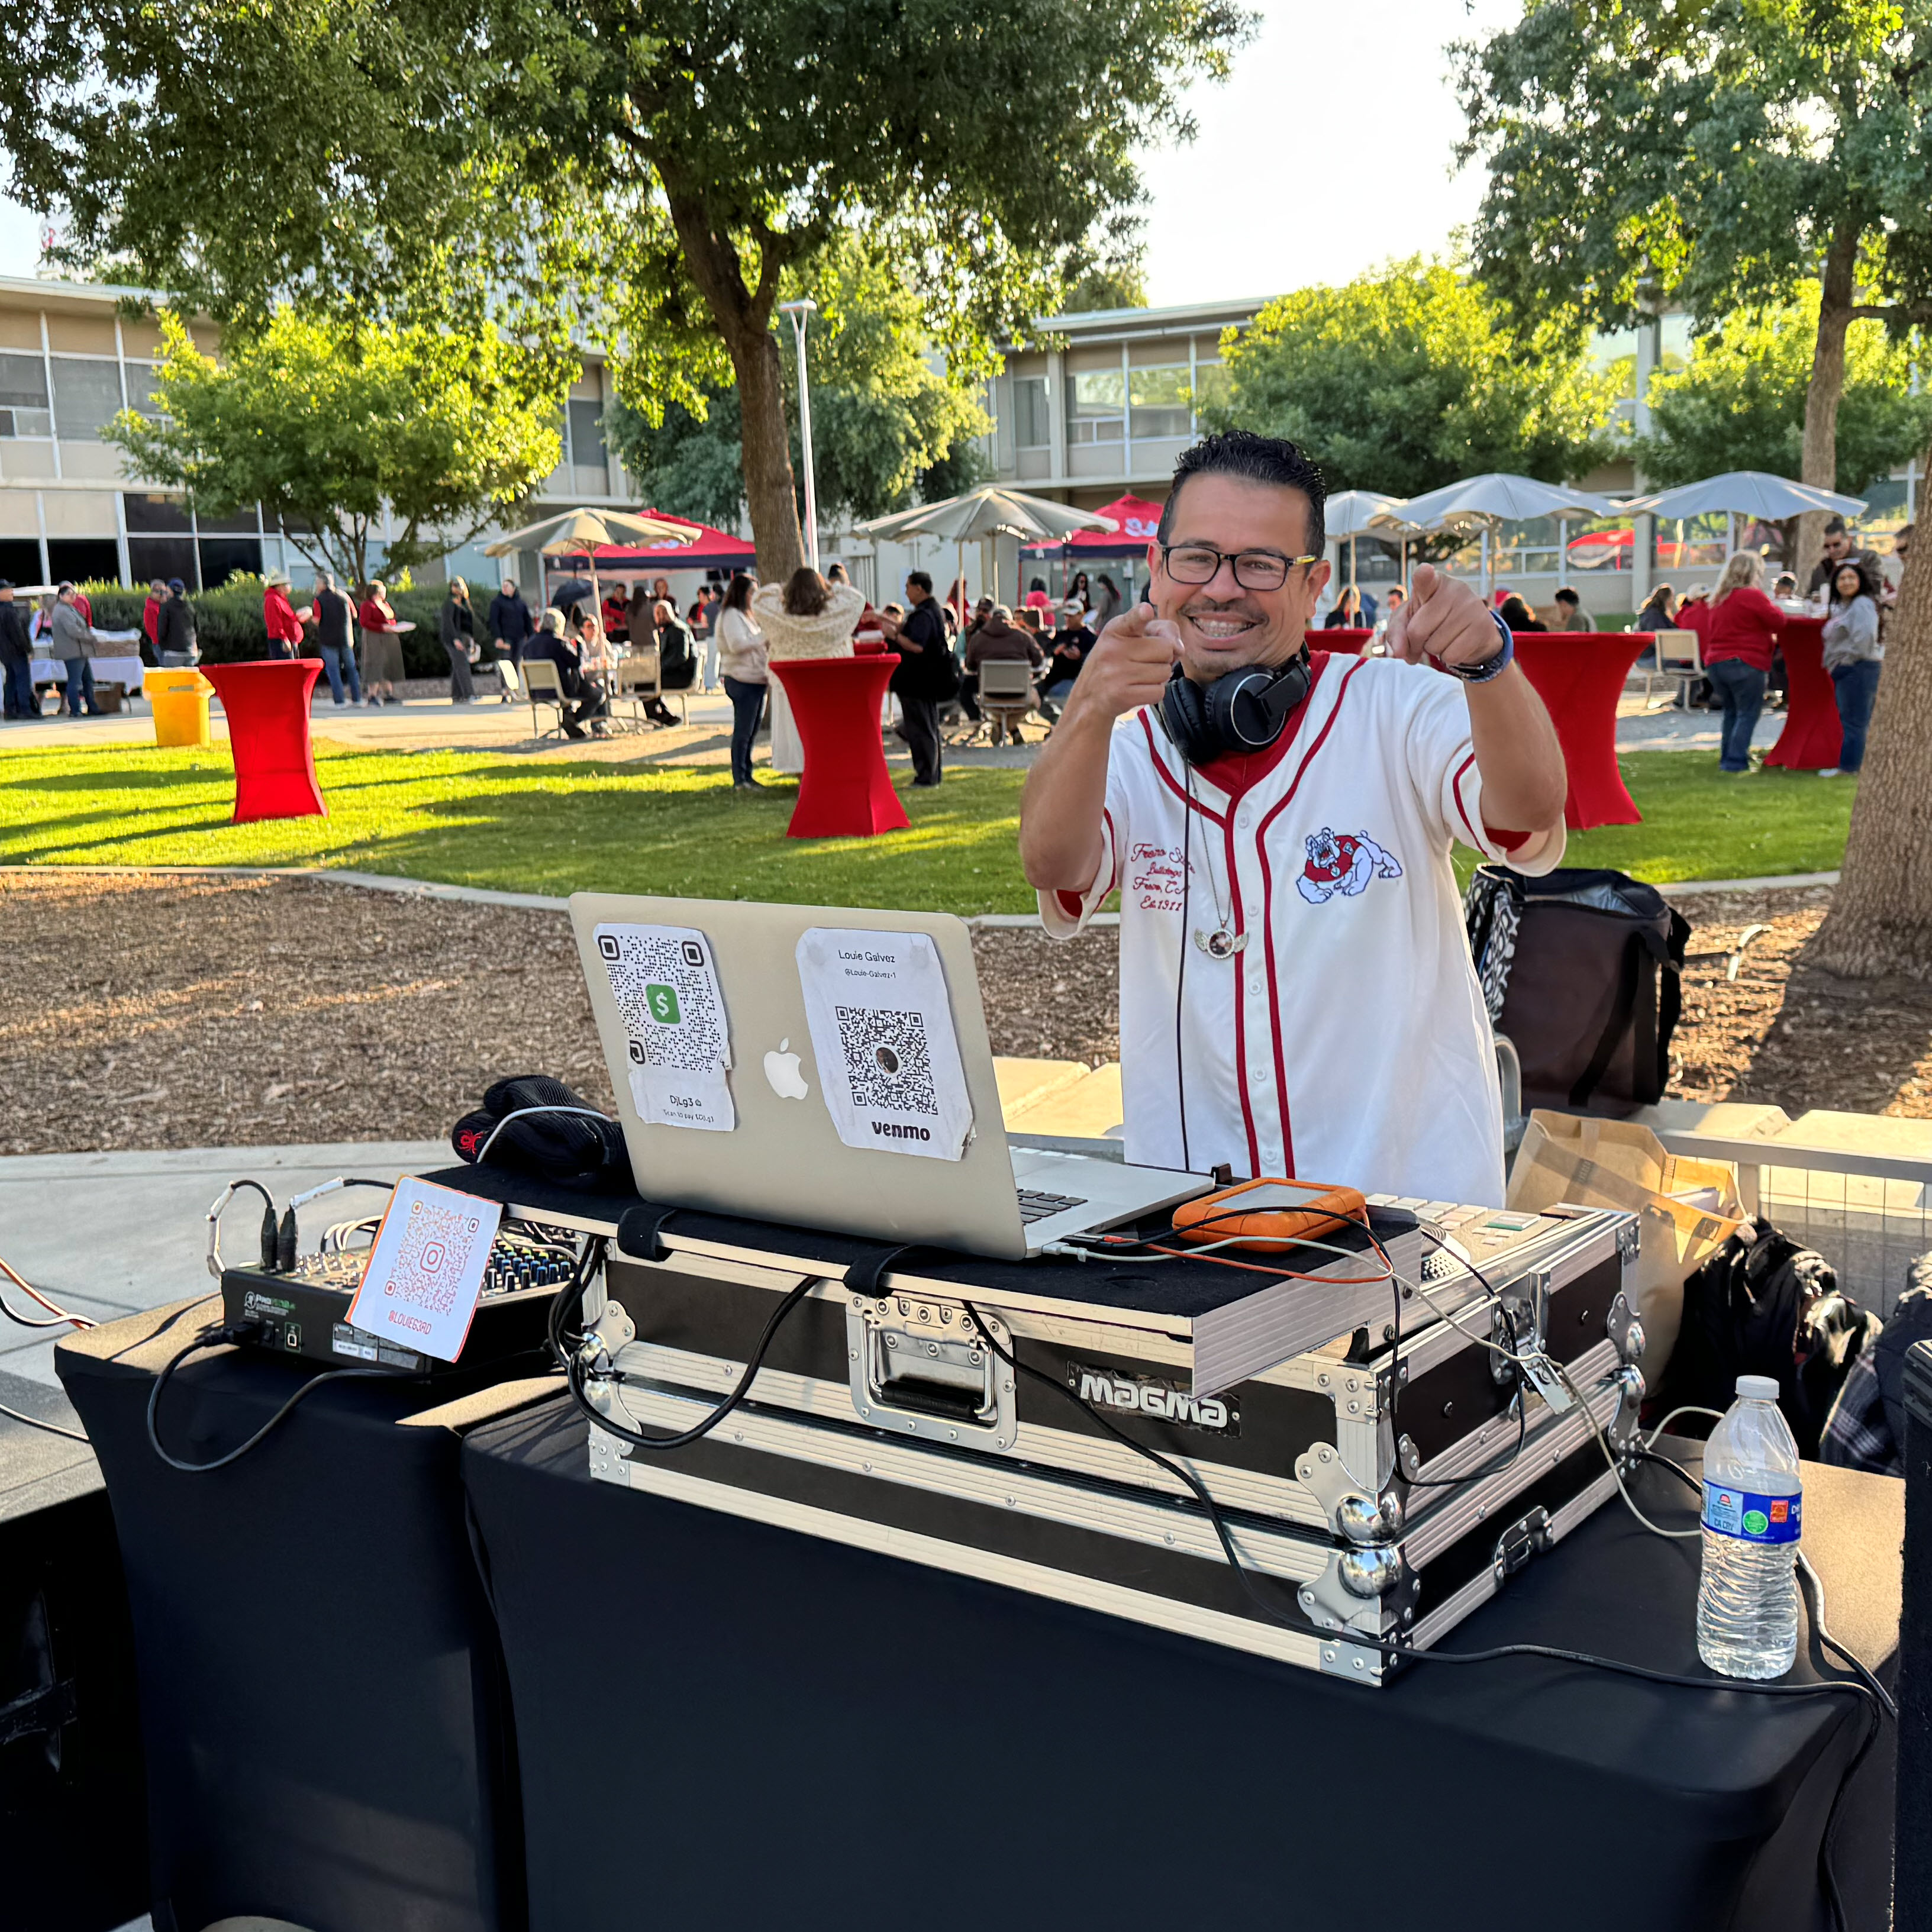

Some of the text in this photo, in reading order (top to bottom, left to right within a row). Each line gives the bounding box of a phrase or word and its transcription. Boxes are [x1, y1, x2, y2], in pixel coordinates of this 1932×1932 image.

[838, 950, 895, 963] Louie Galvez
[871, 1121, 931, 1141] venmo
